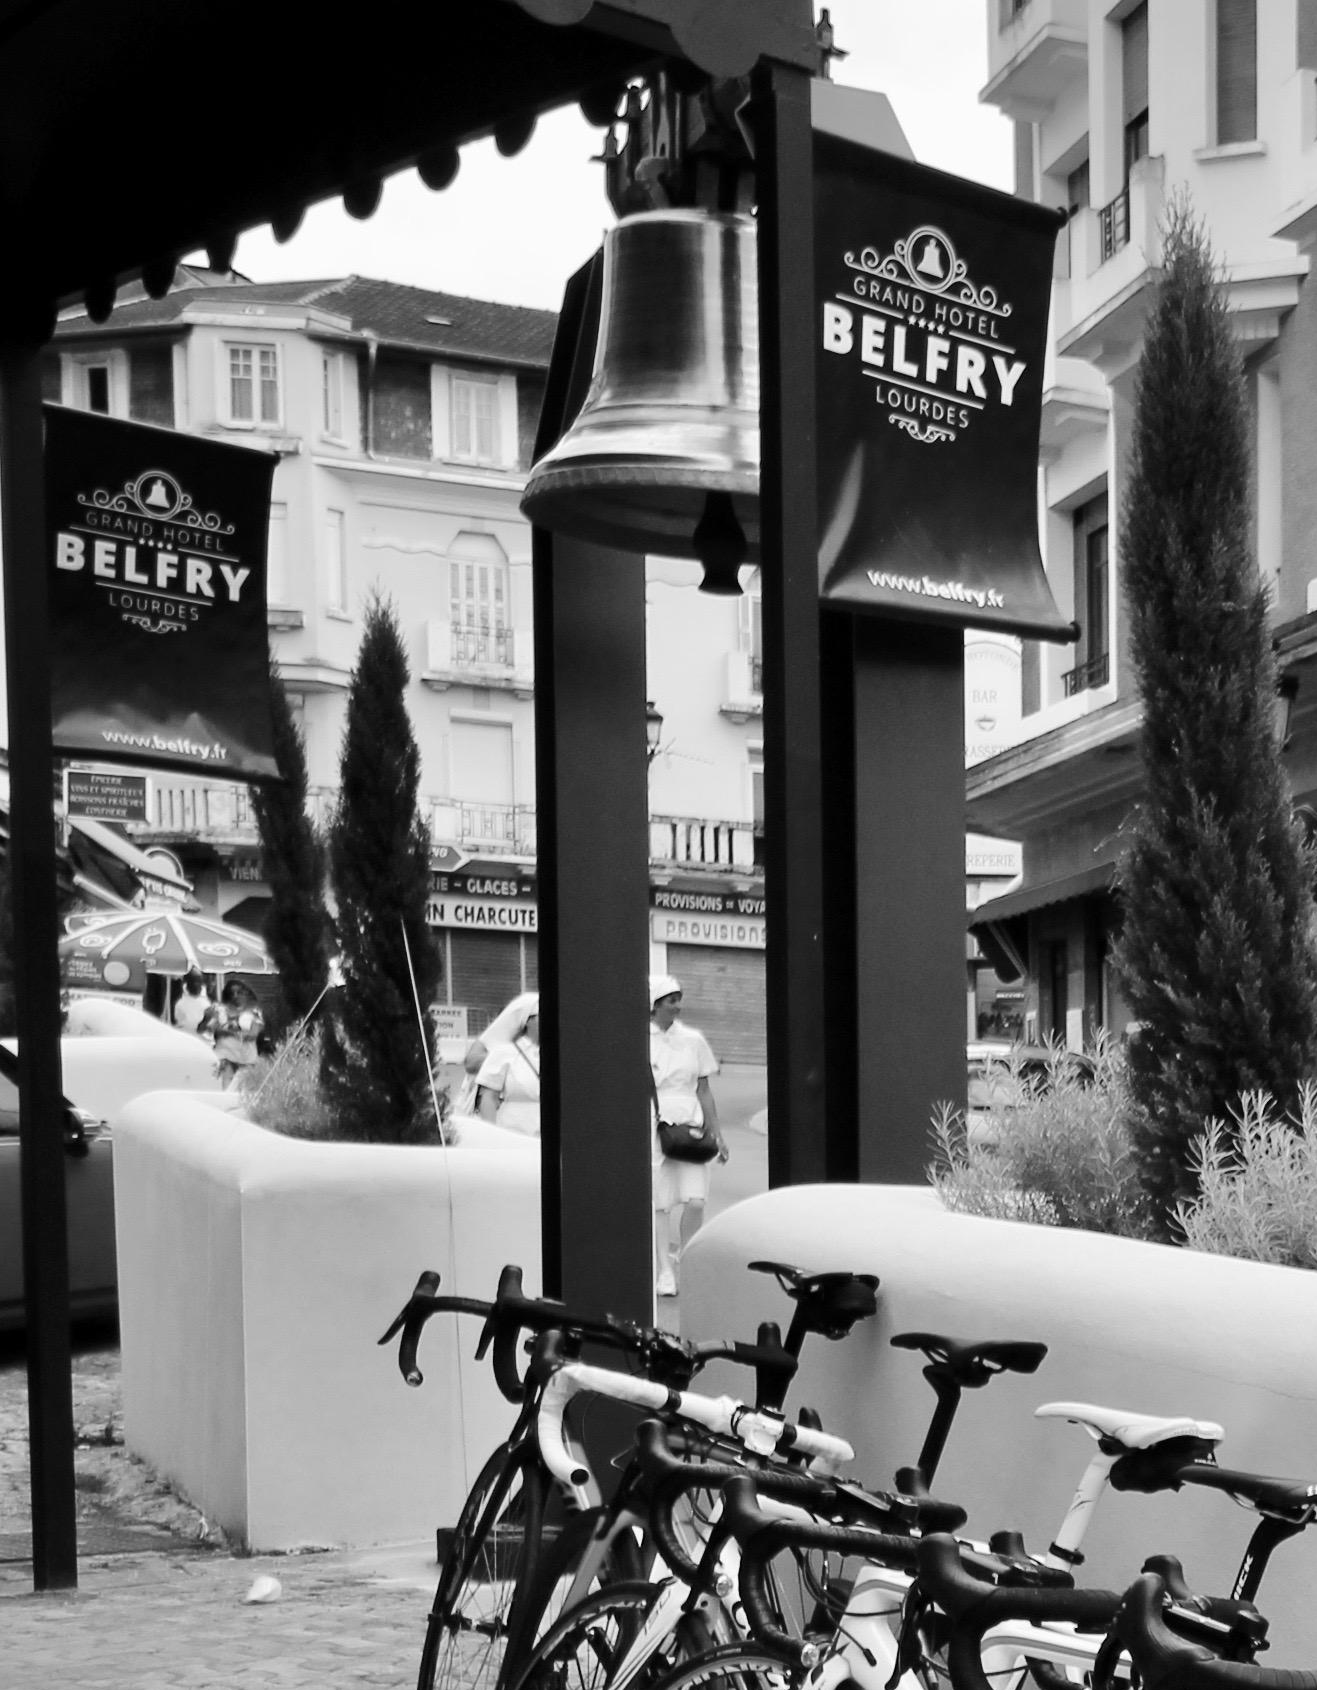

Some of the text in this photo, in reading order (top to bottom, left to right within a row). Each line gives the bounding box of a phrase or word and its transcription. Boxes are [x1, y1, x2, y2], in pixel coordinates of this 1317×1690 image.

[853, 276, 999, 339] GRAND HOTEL
[823, 302, 1027, 407] BELFRY
[875, 385, 969, 428] LOURDES
[86, 512, 223, 551] GRAND HOTEL
[56, 532, 250, 602] BELFRY
[867, 570, 1004, 608] www.belfry.fr
[109, 593, 199, 621] LOURDES
[972, 690, 998, 703] BAR
[102, 731, 226, 759] www.belfry.fr
[467, 878, 518, 896] GLACES
[655, 892, 722, 912] PROVISIONS
[454, 904, 536, 927] CHARCUTE
